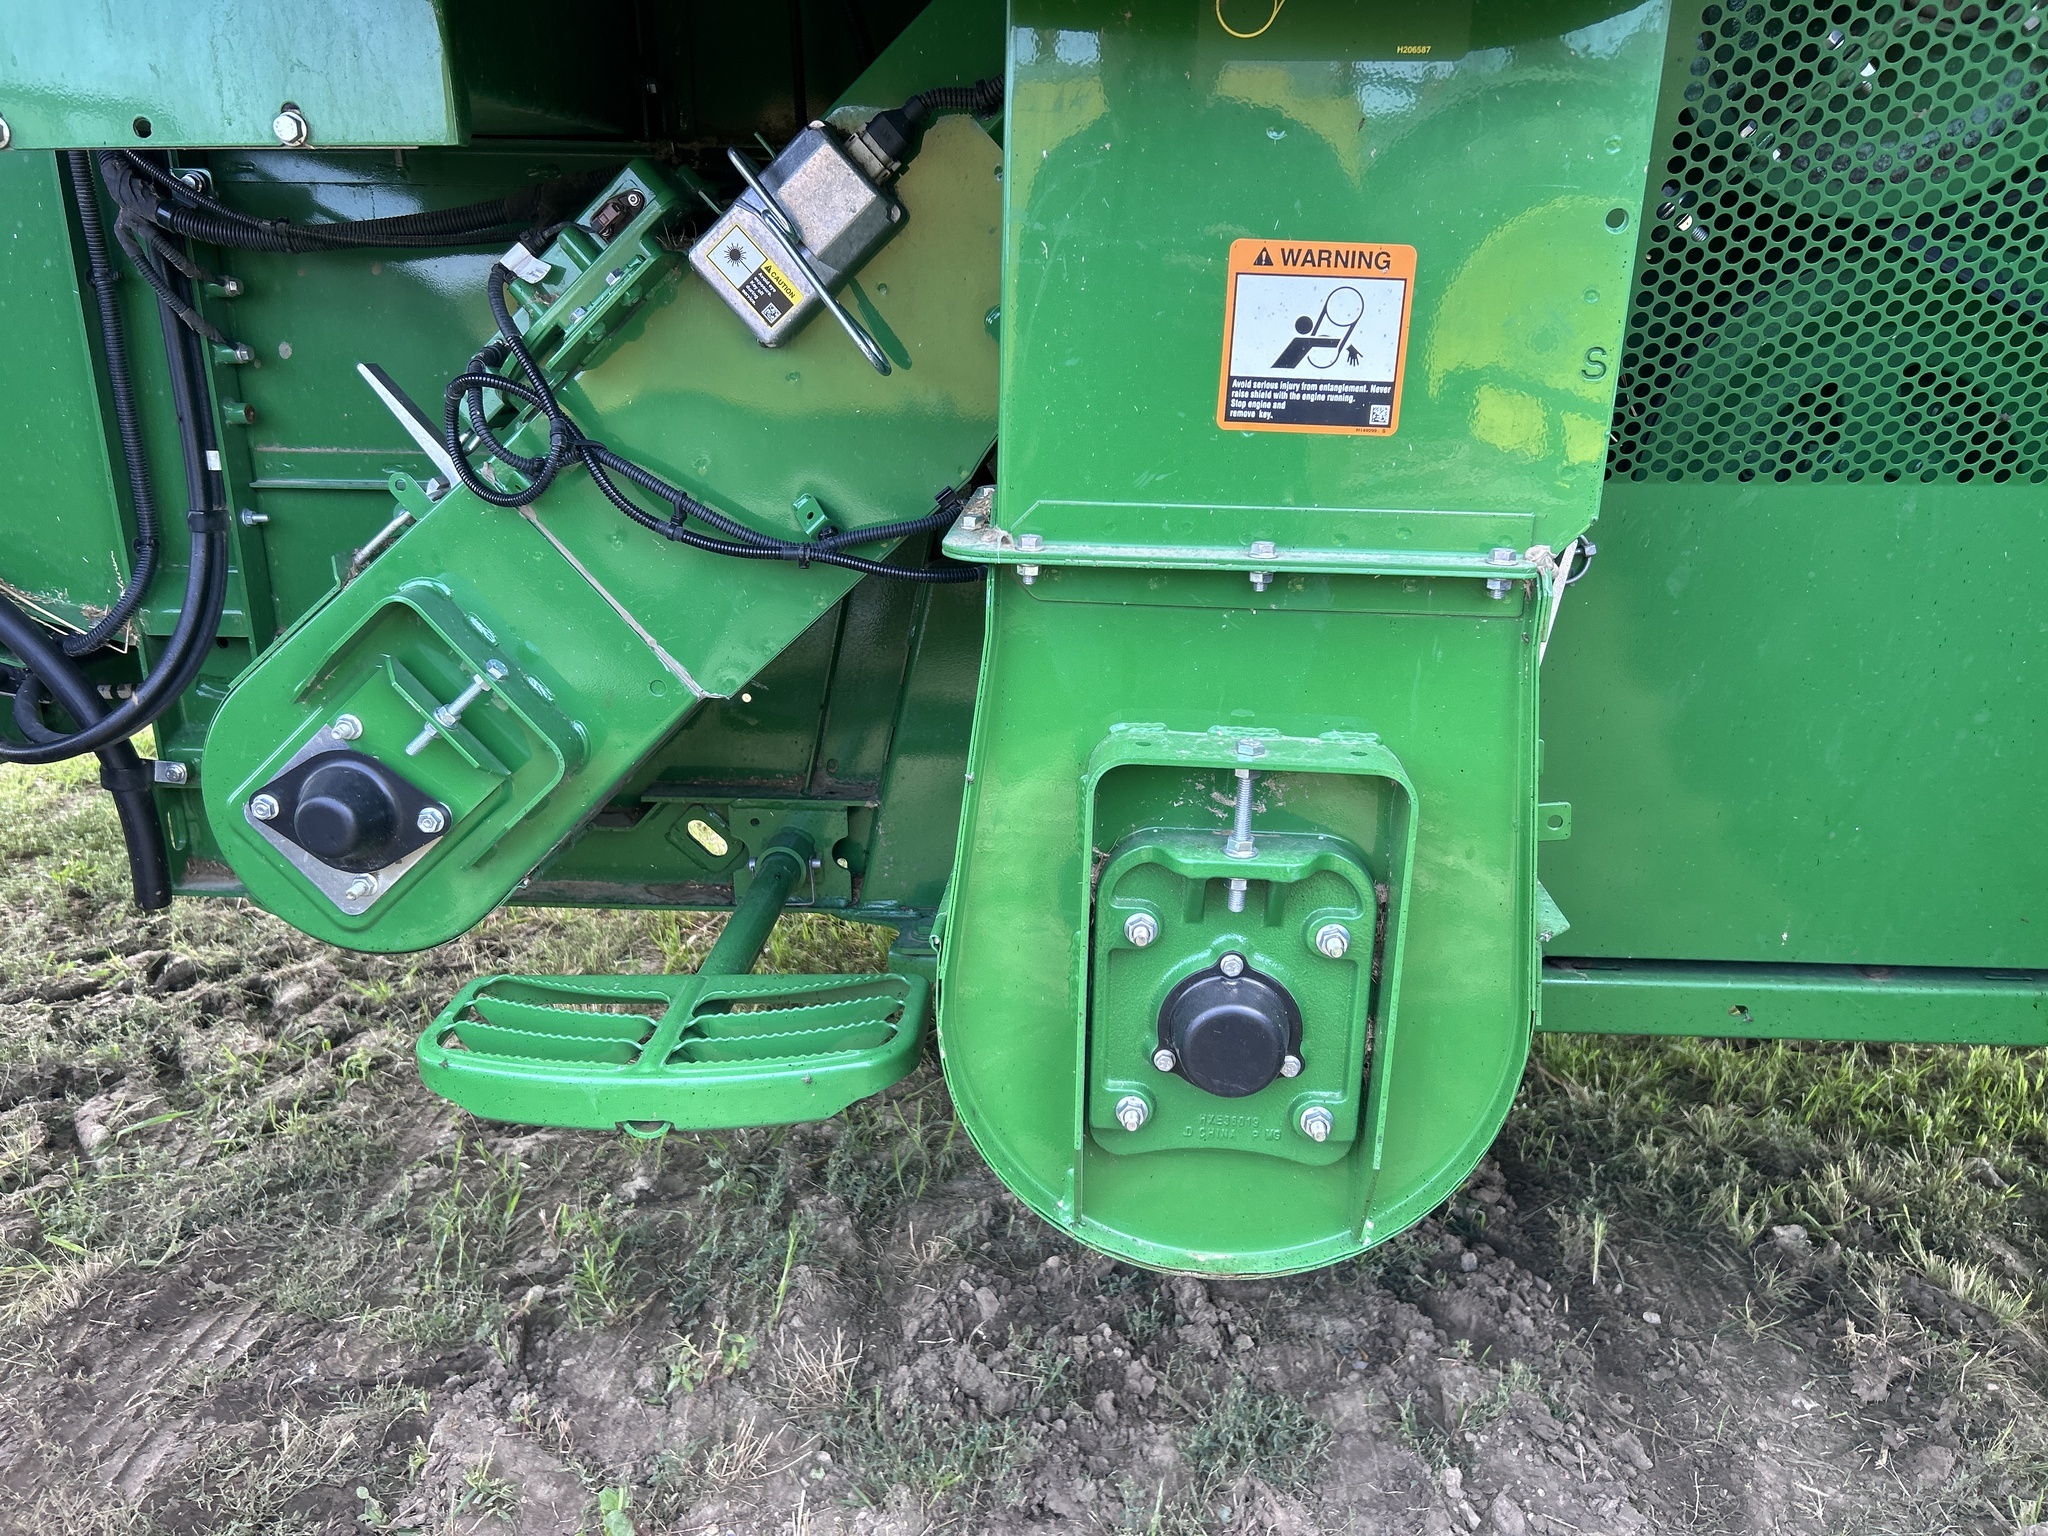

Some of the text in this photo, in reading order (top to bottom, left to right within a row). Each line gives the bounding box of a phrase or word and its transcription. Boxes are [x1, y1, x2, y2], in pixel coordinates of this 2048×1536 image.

[1280, 247, 1392, 271] WARNING
[750, 280, 765, 296] Key off
[753, 276, 772, 297] exposure.
[757, 272, 777, 293] Avoid eye
[770, 271, 796, 299] CAUTION
[741, 288, 756, 306] service.
[745, 284, 759, 300] during
[1581, 346, 1607, 381] S
[1232, 379, 1392, 394] Avoid serious injury from entanglement. Never
[1230, 399, 1286, 410] Stop engine and
[1231, 389, 1356, 404] raise shield with the engine running.
[1229, 410, 1274, 420] remove key.
[1199, 1127, 1237, 1139] CHINA
